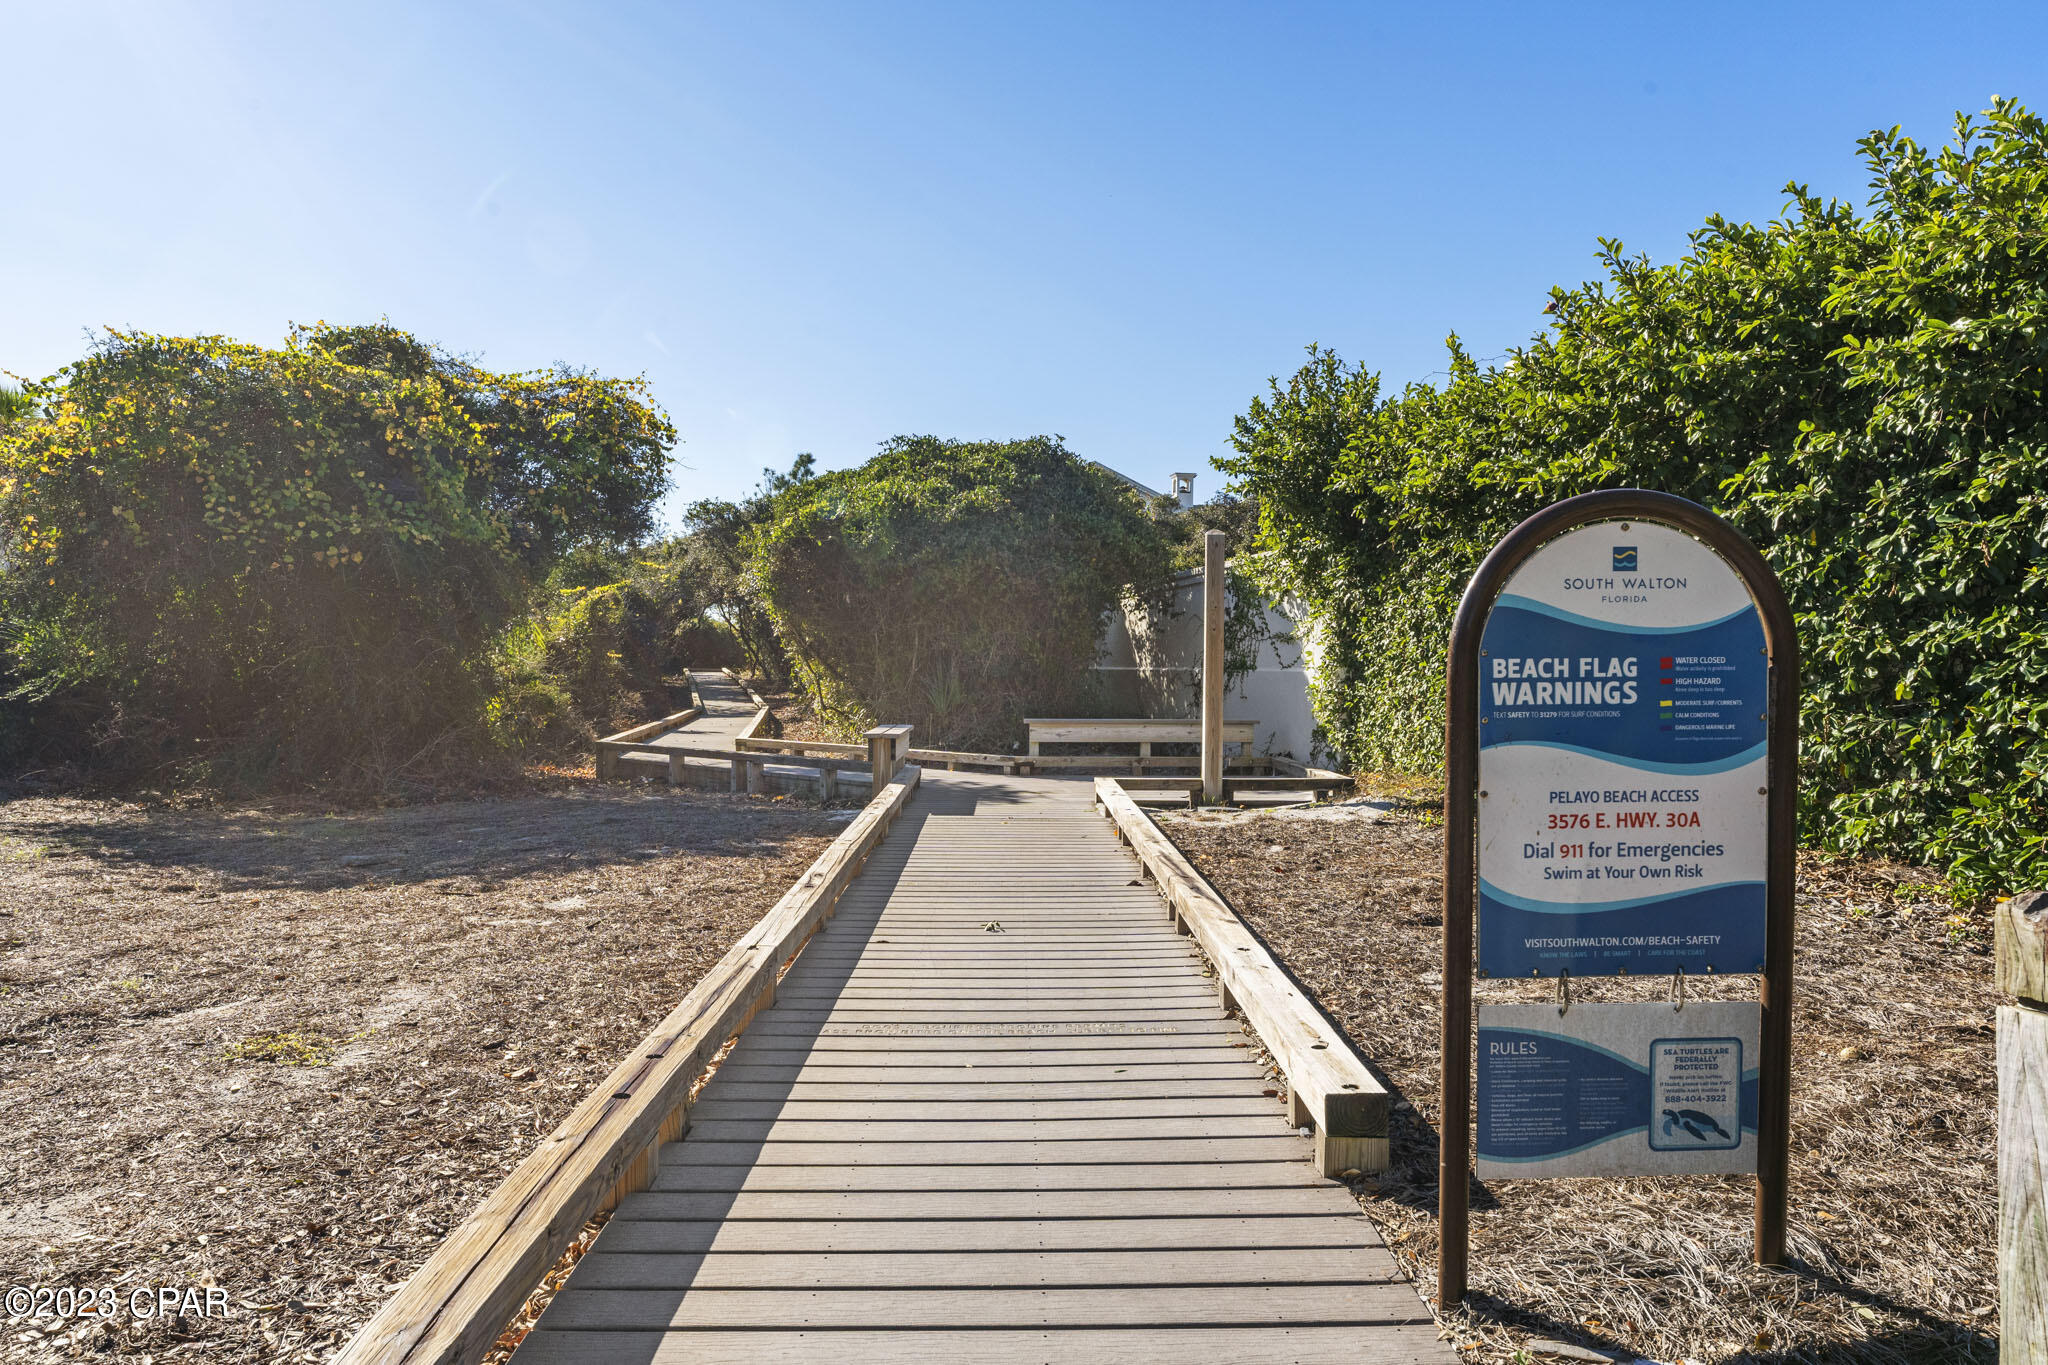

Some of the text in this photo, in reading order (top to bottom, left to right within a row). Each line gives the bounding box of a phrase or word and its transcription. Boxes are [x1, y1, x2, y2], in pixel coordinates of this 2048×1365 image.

[1563, 577, 1687, 590] SOUTH WALTON
[1492, 657, 1638, 679] BEACH FLAG
[1492, 680, 1638, 706] WARNINGS
[1549, 790, 1700, 804] PELAYO BEACH ACCESS
[1548, 812, 1701, 829] 3576 E. HWY. 30A
[1523, 840, 1724, 862] Dial 911 for Emergencies
[1544, 864, 1703, 880] Swim at Your Own Risk
[1524, 935, 1721, 948] VISITSOUTHWALTON.COM/BEACH-SAFETY
[1490, 1042, 1538, 1055] RULES
